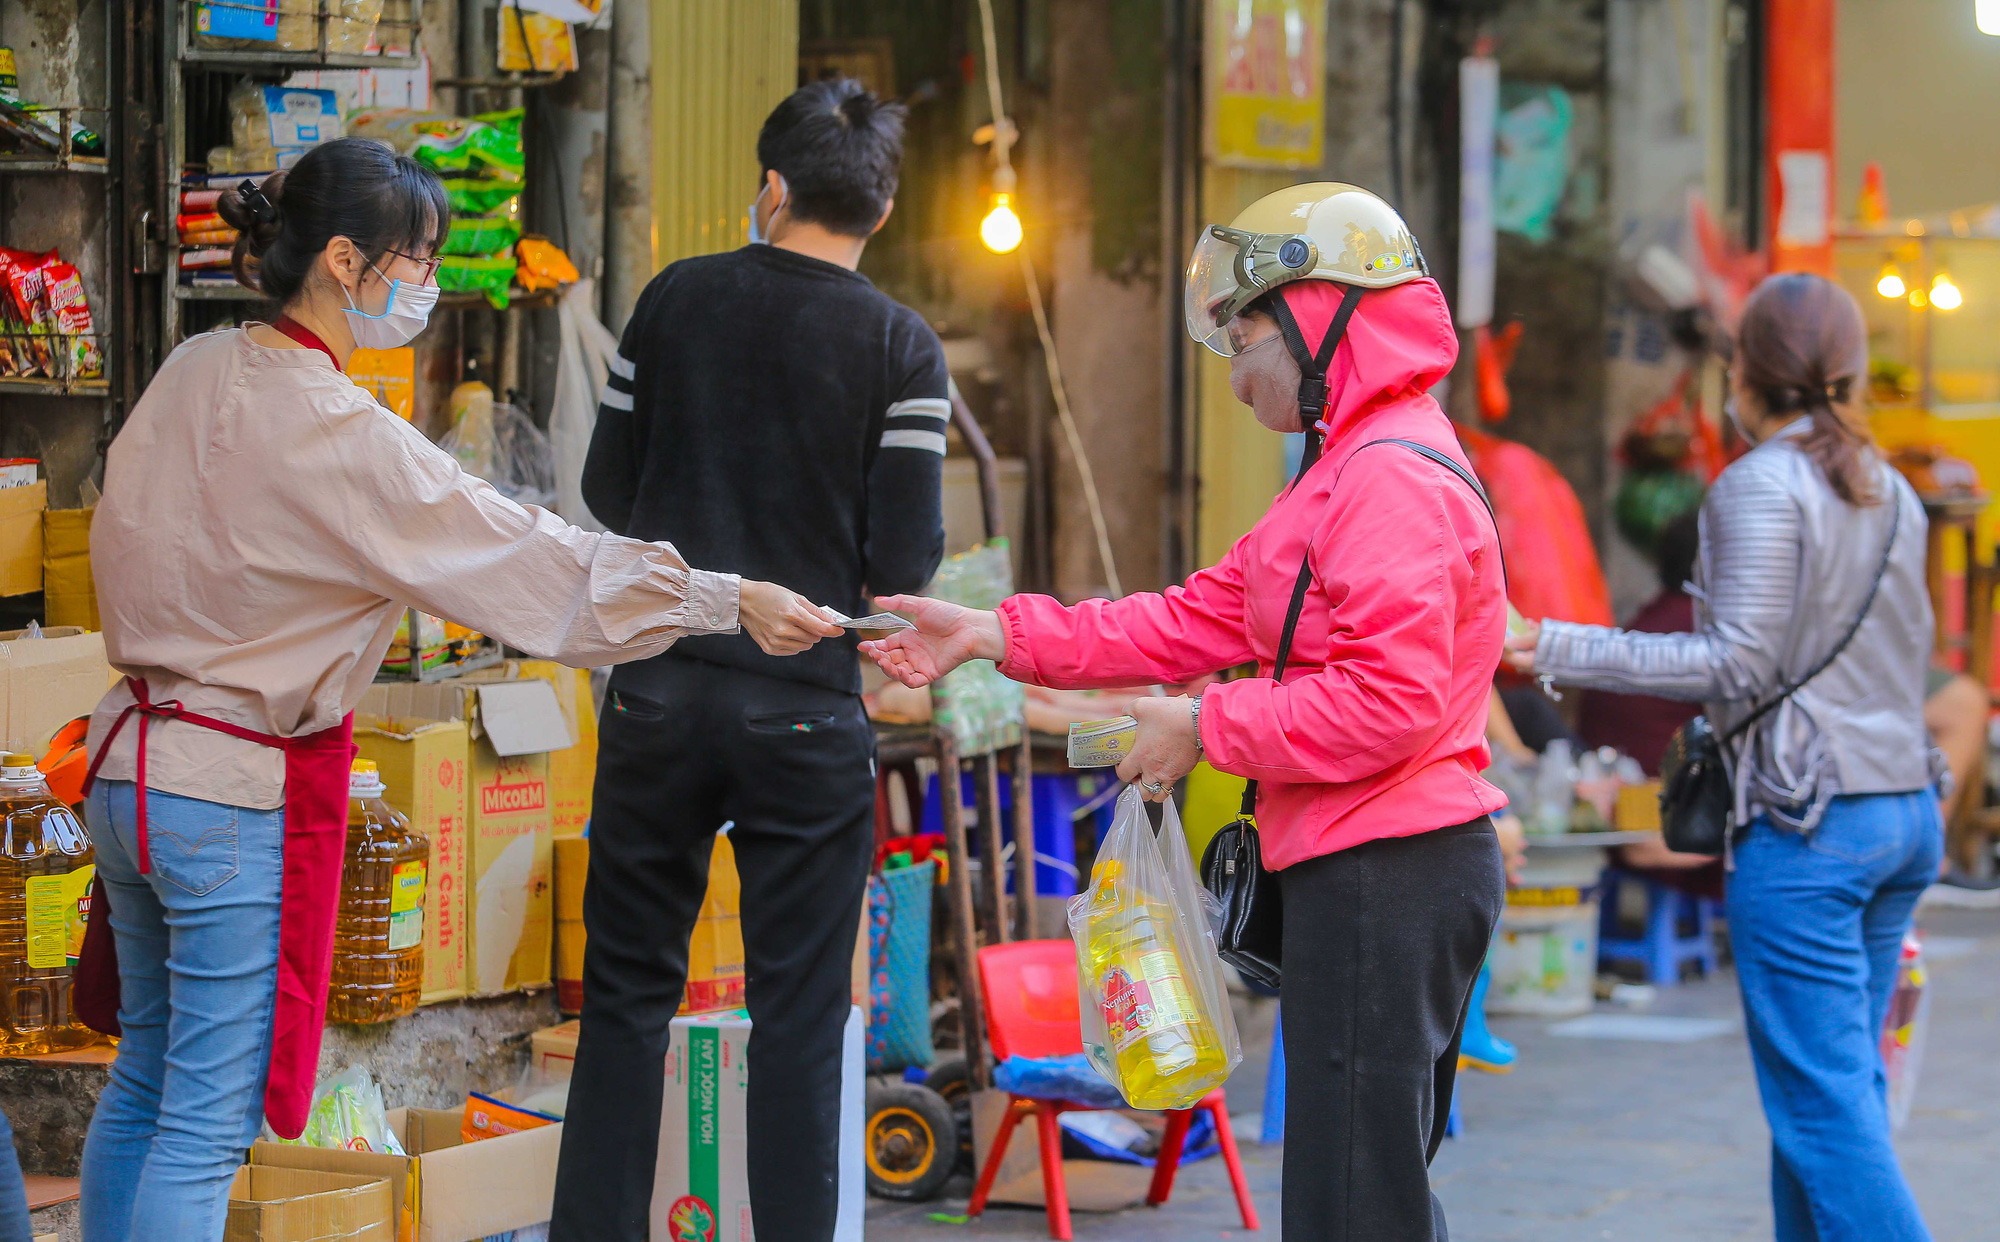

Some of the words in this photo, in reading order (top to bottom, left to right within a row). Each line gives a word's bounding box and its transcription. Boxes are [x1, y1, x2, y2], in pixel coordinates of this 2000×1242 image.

[484, 785, 543, 812] MICOEM
[437, 815, 454, 867] Bột
[439, 873, 454, 948] Canh
[1102, 987, 1136, 1010] Neptune
[700, 1039, 714, 1069] LAN
[700, 1071, 715, 1111] NGỌC
[700, 1113, 714, 1145] HOA
